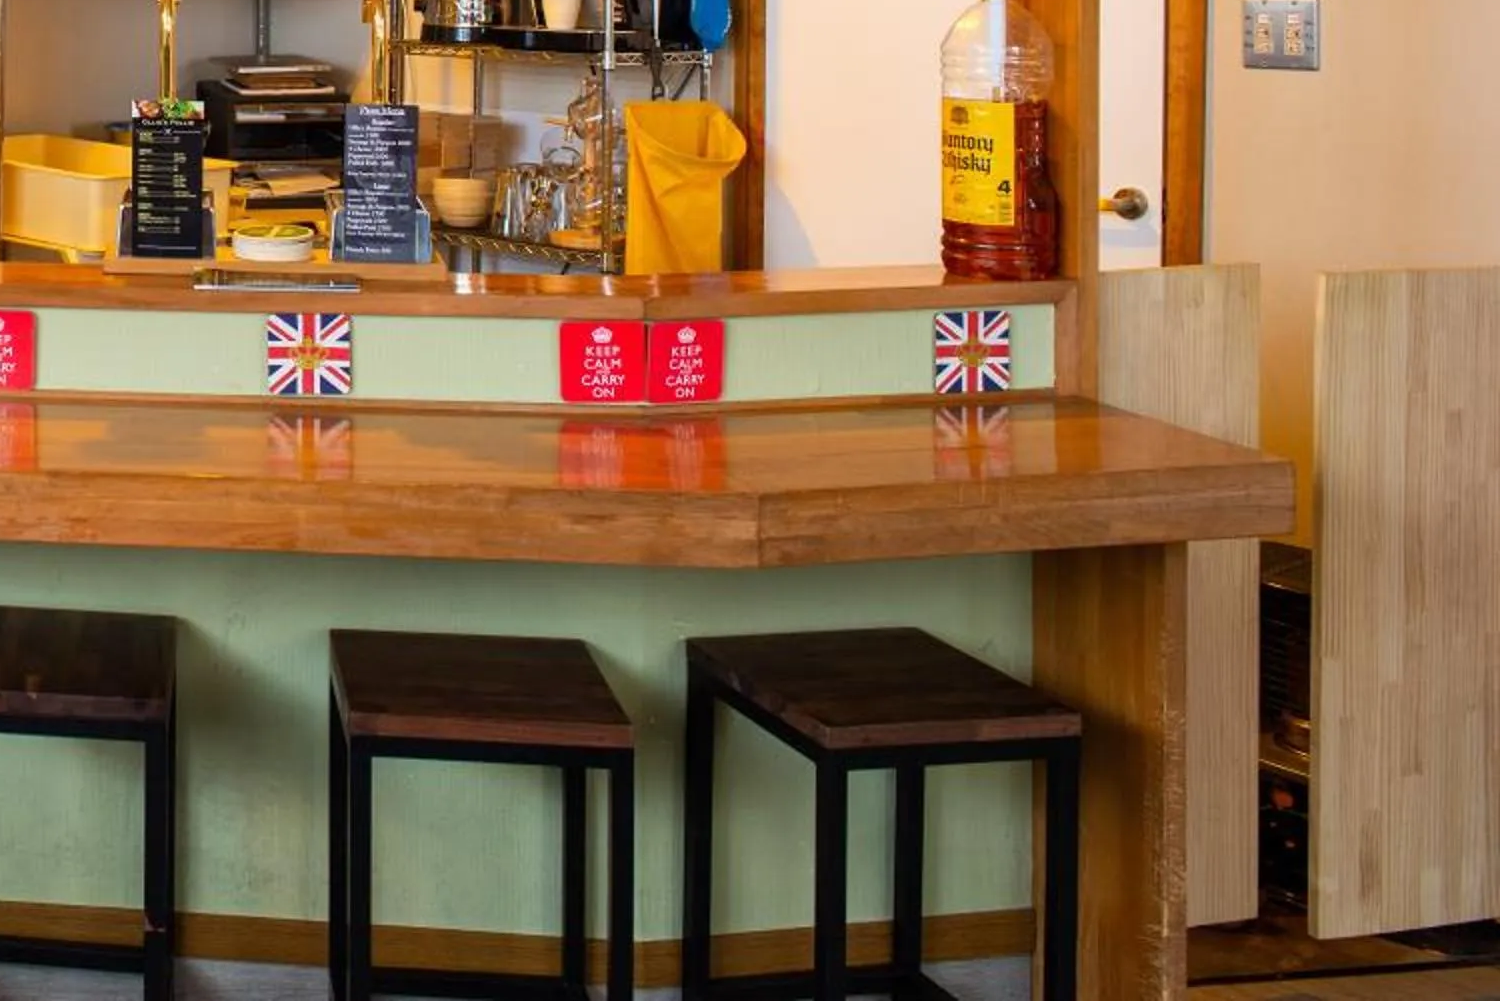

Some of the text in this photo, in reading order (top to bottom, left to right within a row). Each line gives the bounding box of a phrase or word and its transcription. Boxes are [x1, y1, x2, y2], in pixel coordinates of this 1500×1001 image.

[997, 179, 1012, 195] 4
[585, 346, 621, 357] KEEP
[671, 346, 703, 357] KEEP
[583, 358, 622, 369] CALM
[669, 358, 703, 369] CALM
[581, 374, 625, 387] CARRY
[665, 374, 705, 387] CARRY
[592, 387, 616, 398] ON
[675, 387, 695, 398] ON
